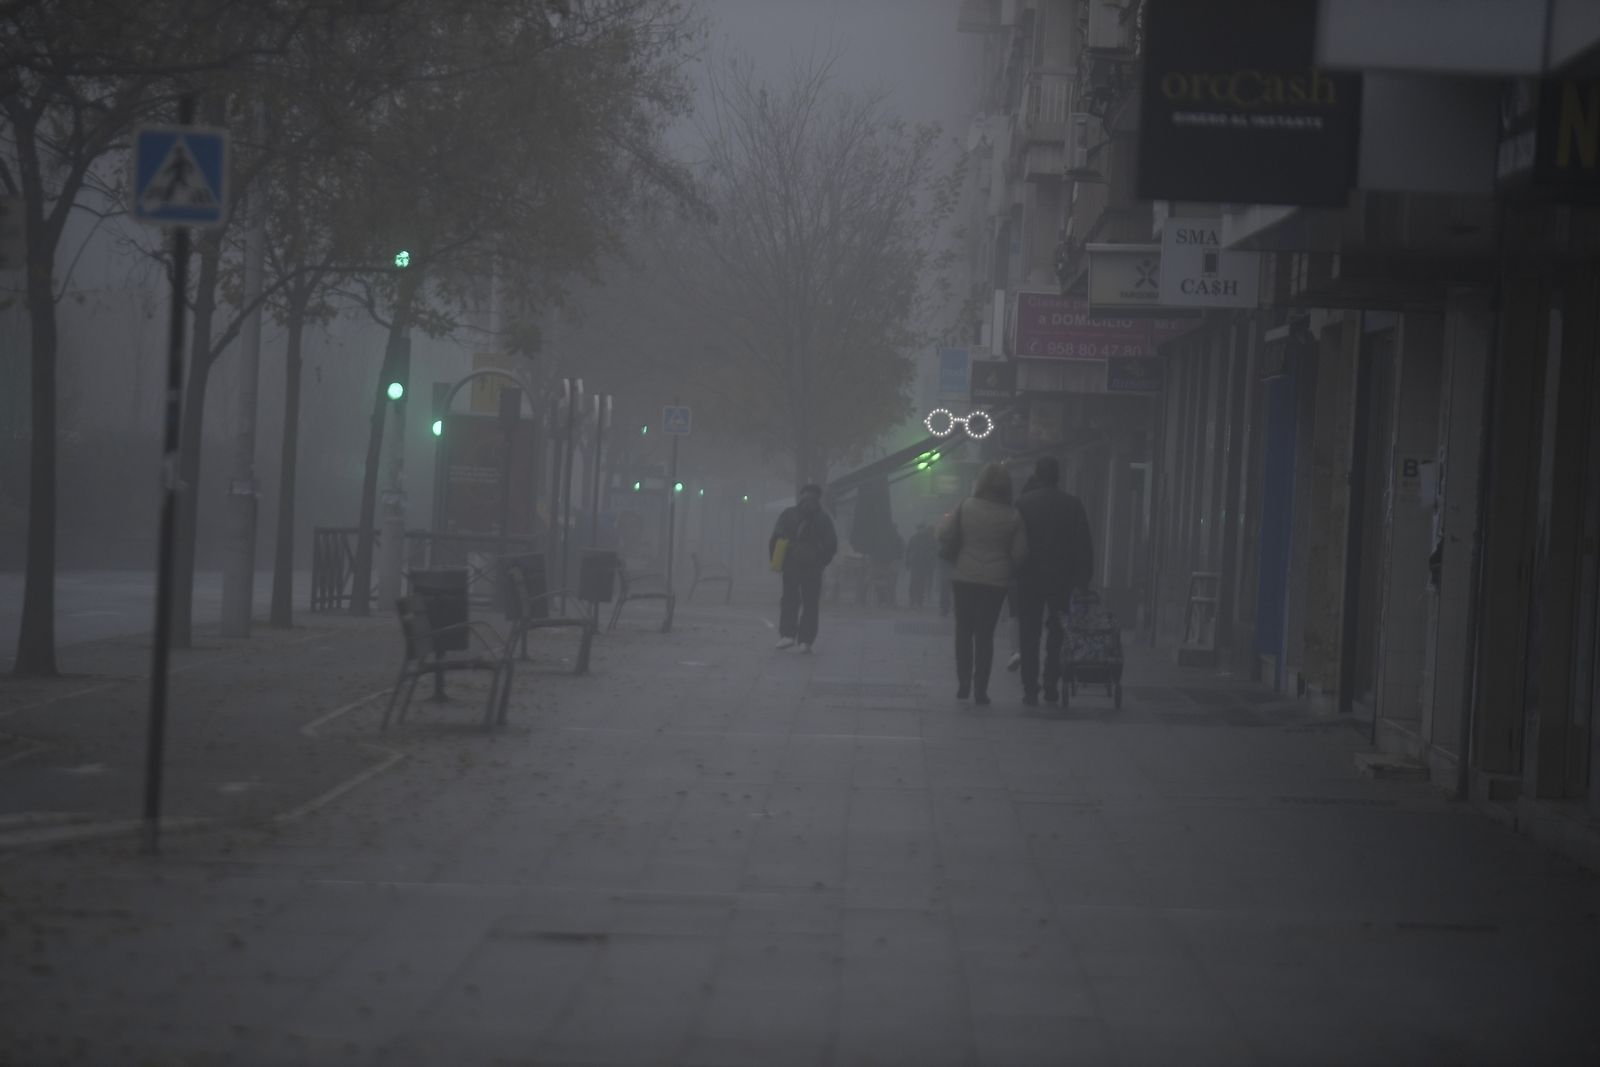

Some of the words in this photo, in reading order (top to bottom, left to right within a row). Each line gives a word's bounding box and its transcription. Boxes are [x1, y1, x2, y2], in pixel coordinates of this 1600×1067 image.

[1162, 67, 1337, 107] oroCash
[1180, 278, 1239, 296] CA$H
[1047, 341, 1074, 355] 958
[1077, 342, 1097, 356] 80
